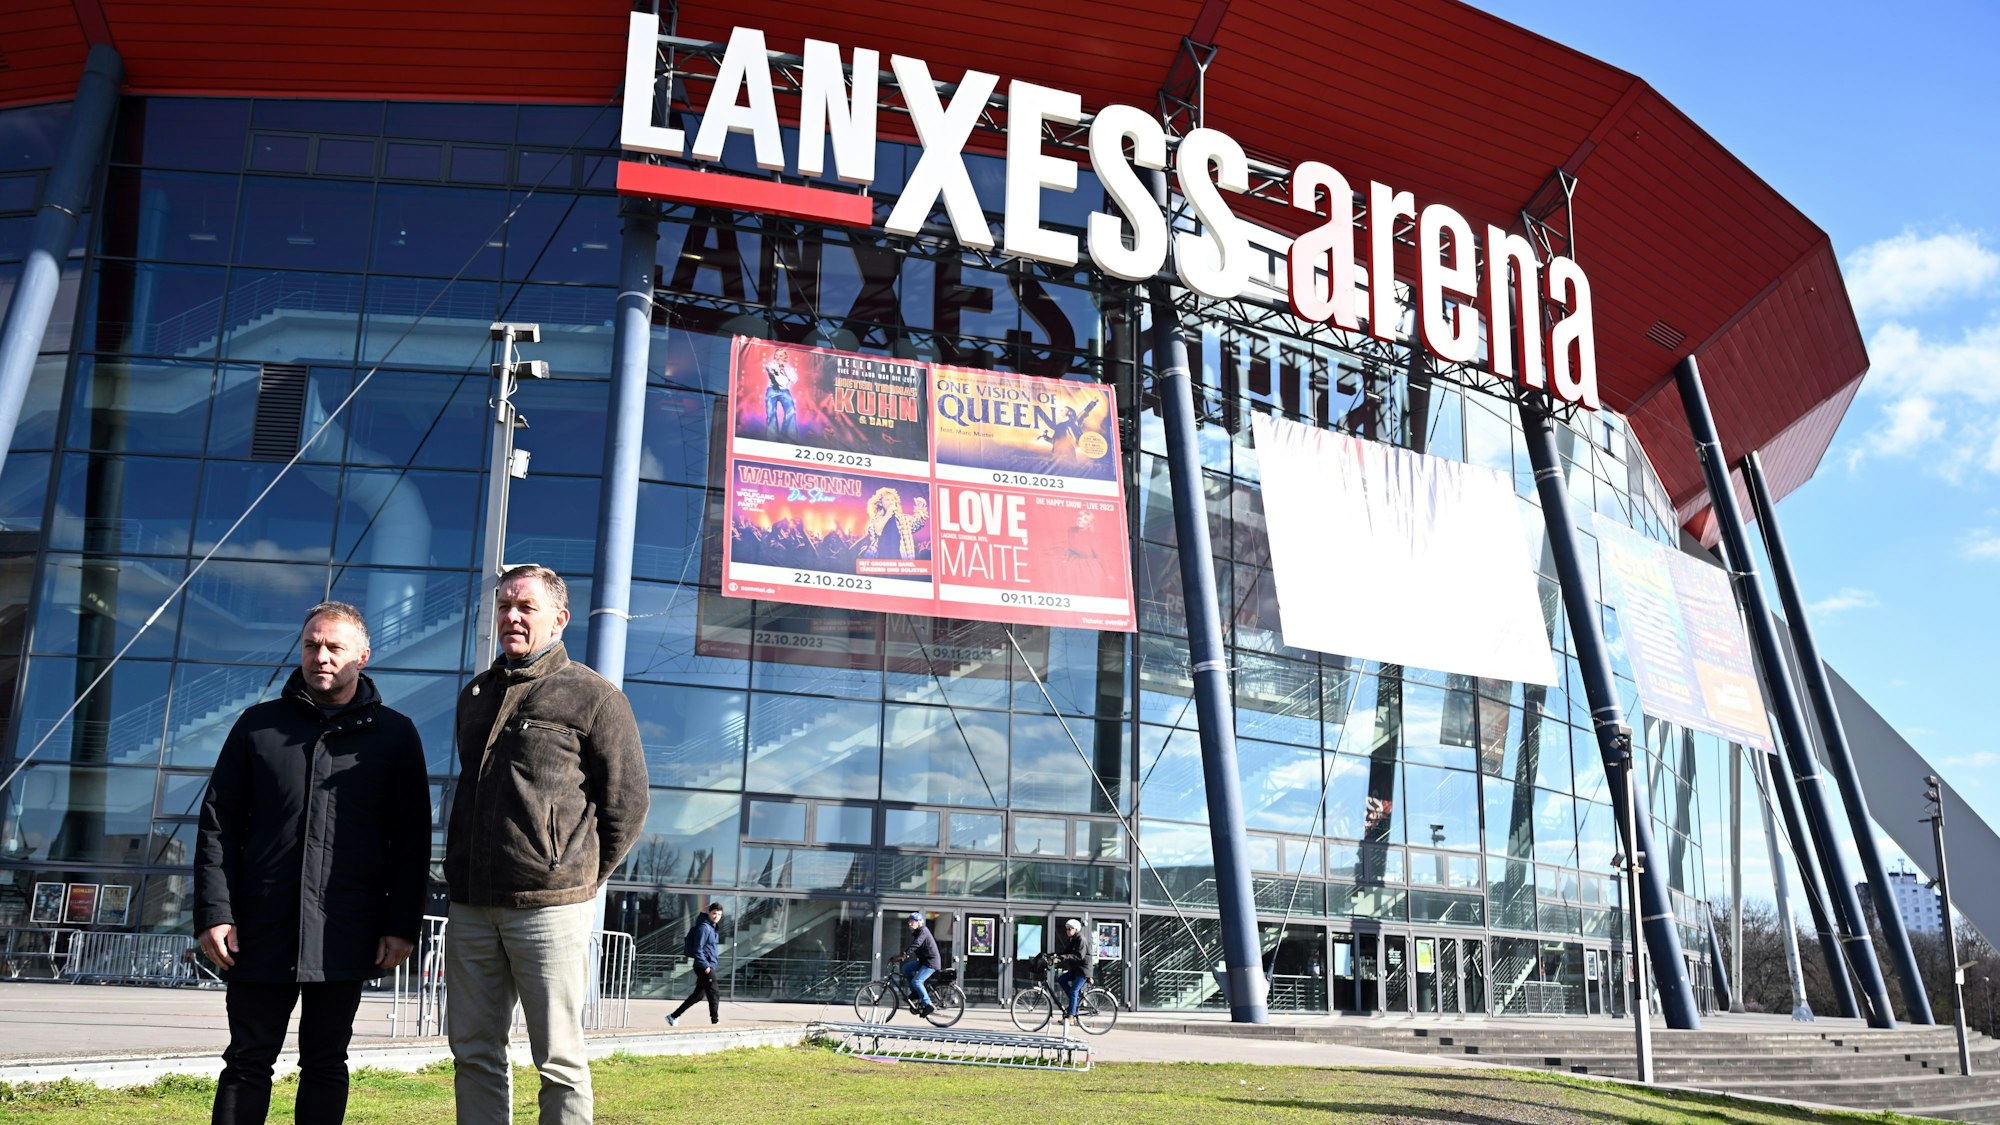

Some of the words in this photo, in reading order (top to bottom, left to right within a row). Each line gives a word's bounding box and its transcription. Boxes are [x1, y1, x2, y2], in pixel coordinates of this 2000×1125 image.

[620, 11, 1249, 299] LANXESS
[1288, 160, 1600, 411] arena
[837, 358, 872, 370] HELLO
[881, 364, 916, 376] AGAIN
[835, 377, 873, 391] DIETER
[874, 382, 918, 398] THOMAS
[937, 379, 970, 395] ONE
[976, 385, 1031, 403] VISION
[1037, 392, 1057, 405] OF
[834, 386, 918, 423] KUHN
[937, 393, 1057, 432] QUEEN
[859, 415, 867, 424] &
[869, 418, 895, 428] BAND
[795, 448, 872, 467] 22.09.2023
[738, 465, 862, 497] WAHNSINN!
[993, 473, 1064, 488] 02.10.2023
[736, 491, 775, 500] WOLFGANG
[787, 487, 807, 502] Die
[807, 487, 836, 504] Show
[1035, 497, 1044, 506] DIE
[1046, 499, 1064, 507] HAPPY
[1066, 501, 1082, 509] SHOW
[1086, 502, 1099, 510] LIVE
[1099, 503, 1114, 511] 2023
[737, 501, 758, 509] PARTY
[940, 539, 1031, 583] MAITE
[794, 572, 873, 590] 22.10.2023
[1001, 592, 1071, 608] 09.11.2023
